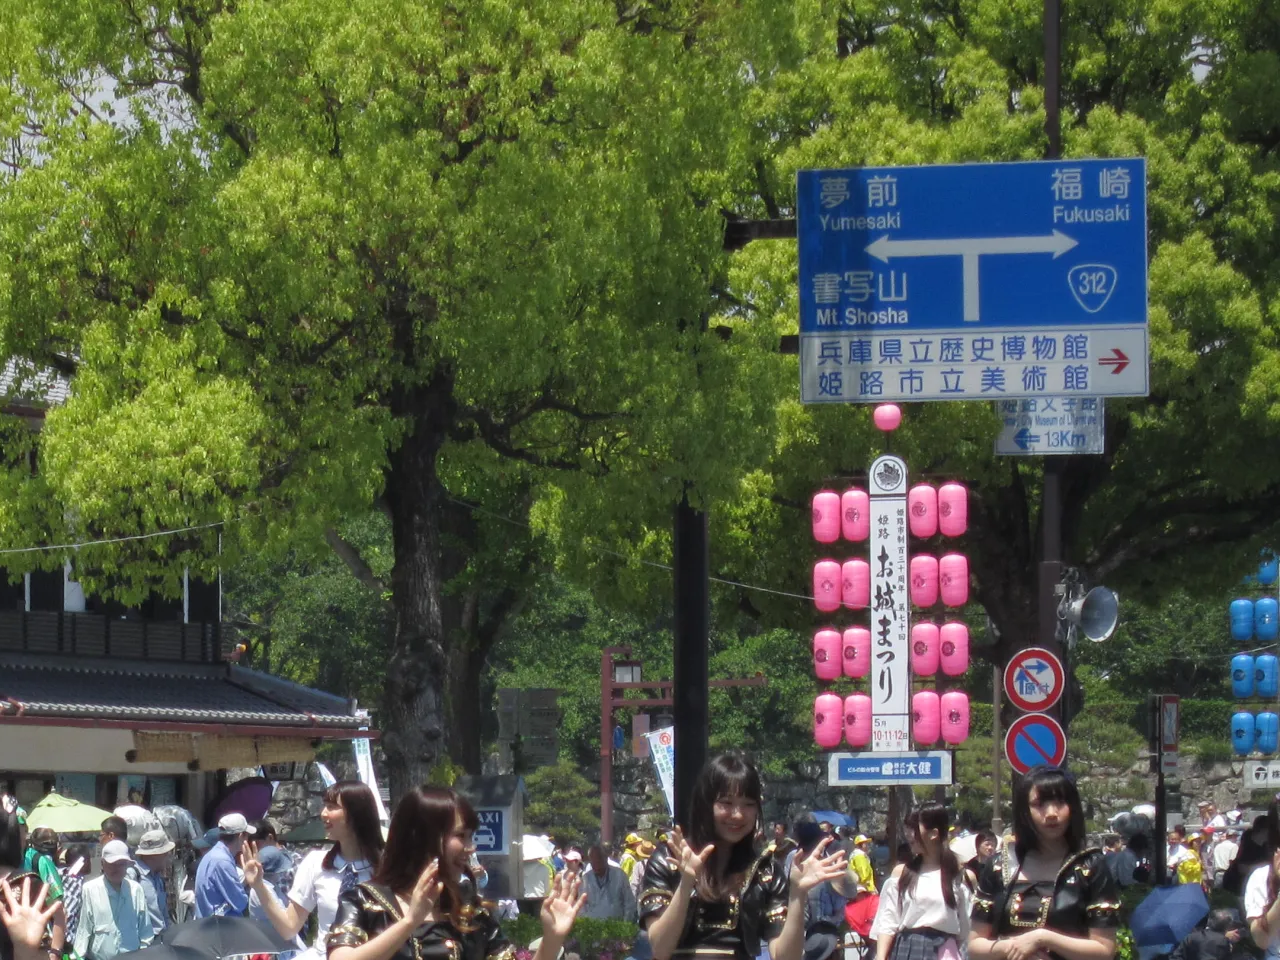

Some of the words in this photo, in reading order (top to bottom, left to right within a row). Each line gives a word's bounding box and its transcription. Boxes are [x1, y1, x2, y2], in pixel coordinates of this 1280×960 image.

[819, 175, 898, 208] 夢前
[1051, 167, 1132, 202] 福崎
[820, 212, 901, 231] Yumesaki
[1053, 205, 1130, 223] Fukusaki
[812, 270, 908, 304] 書写山
[1079, 272, 1106, 294] 312
[817, 334, 1089, 366] 兵庫県立歴史博物館
[818, 365, 1090, 396] 姫路市立美術館
[877, 514, 891, 540] 姫路
[873, 544, 898, 704] お城まつり
[874, 718, 887, 728] 5月
[906, 762, 932, 775] 大健
[476, 812, 499, 823] AXI
